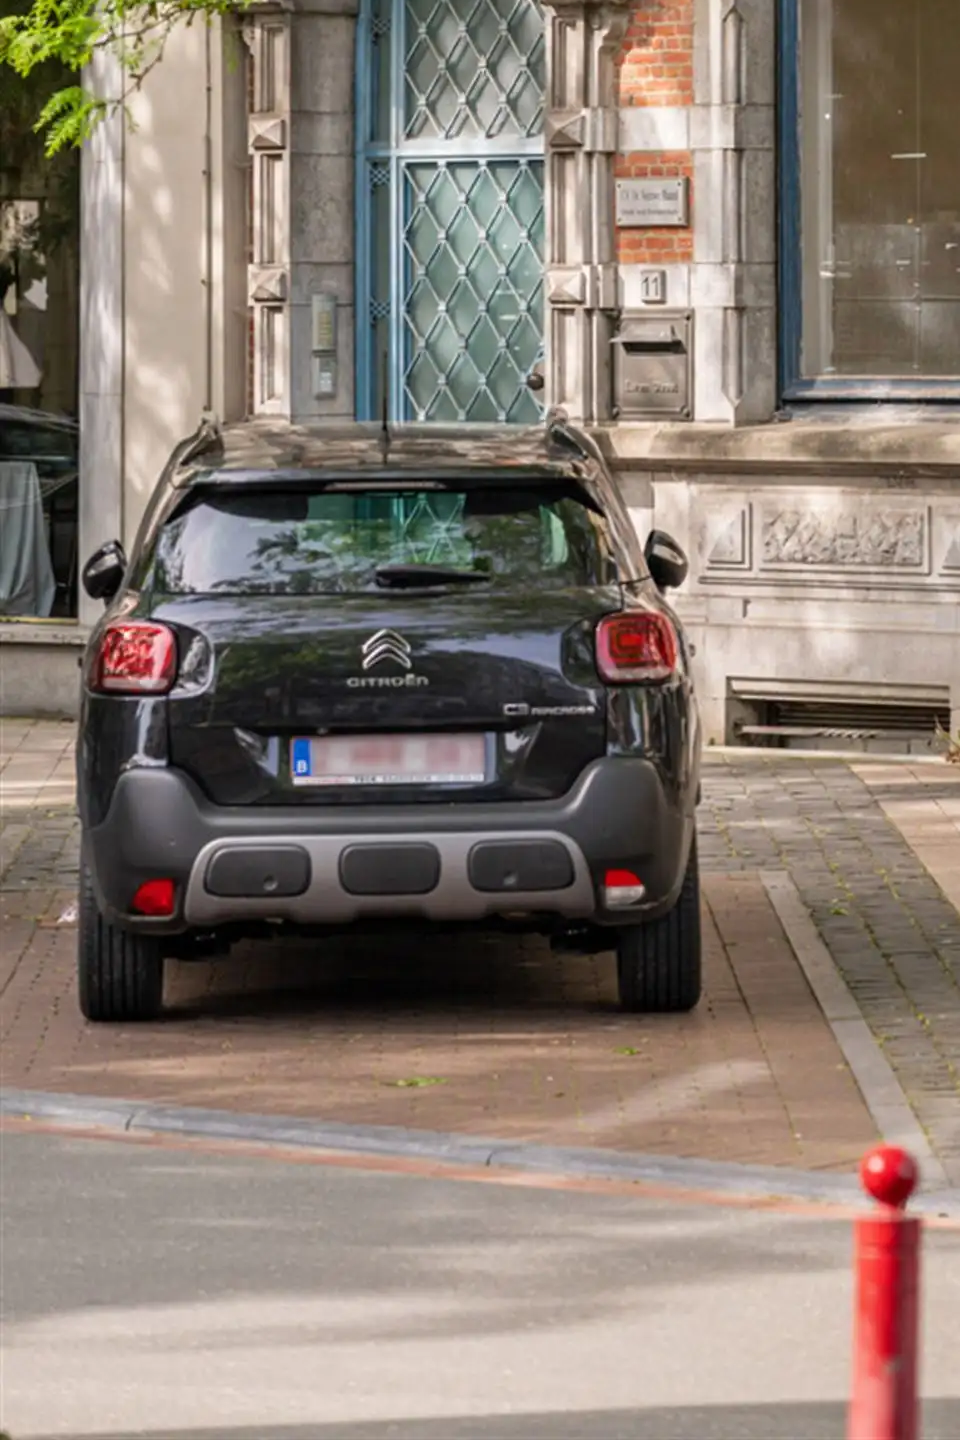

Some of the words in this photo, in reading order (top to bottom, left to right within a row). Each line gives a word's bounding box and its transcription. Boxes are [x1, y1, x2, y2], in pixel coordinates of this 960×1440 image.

[641, 276, 659, 296] 11
[346, 673, 430, 688] CITROËN
[295, 759, 308, 774] B
